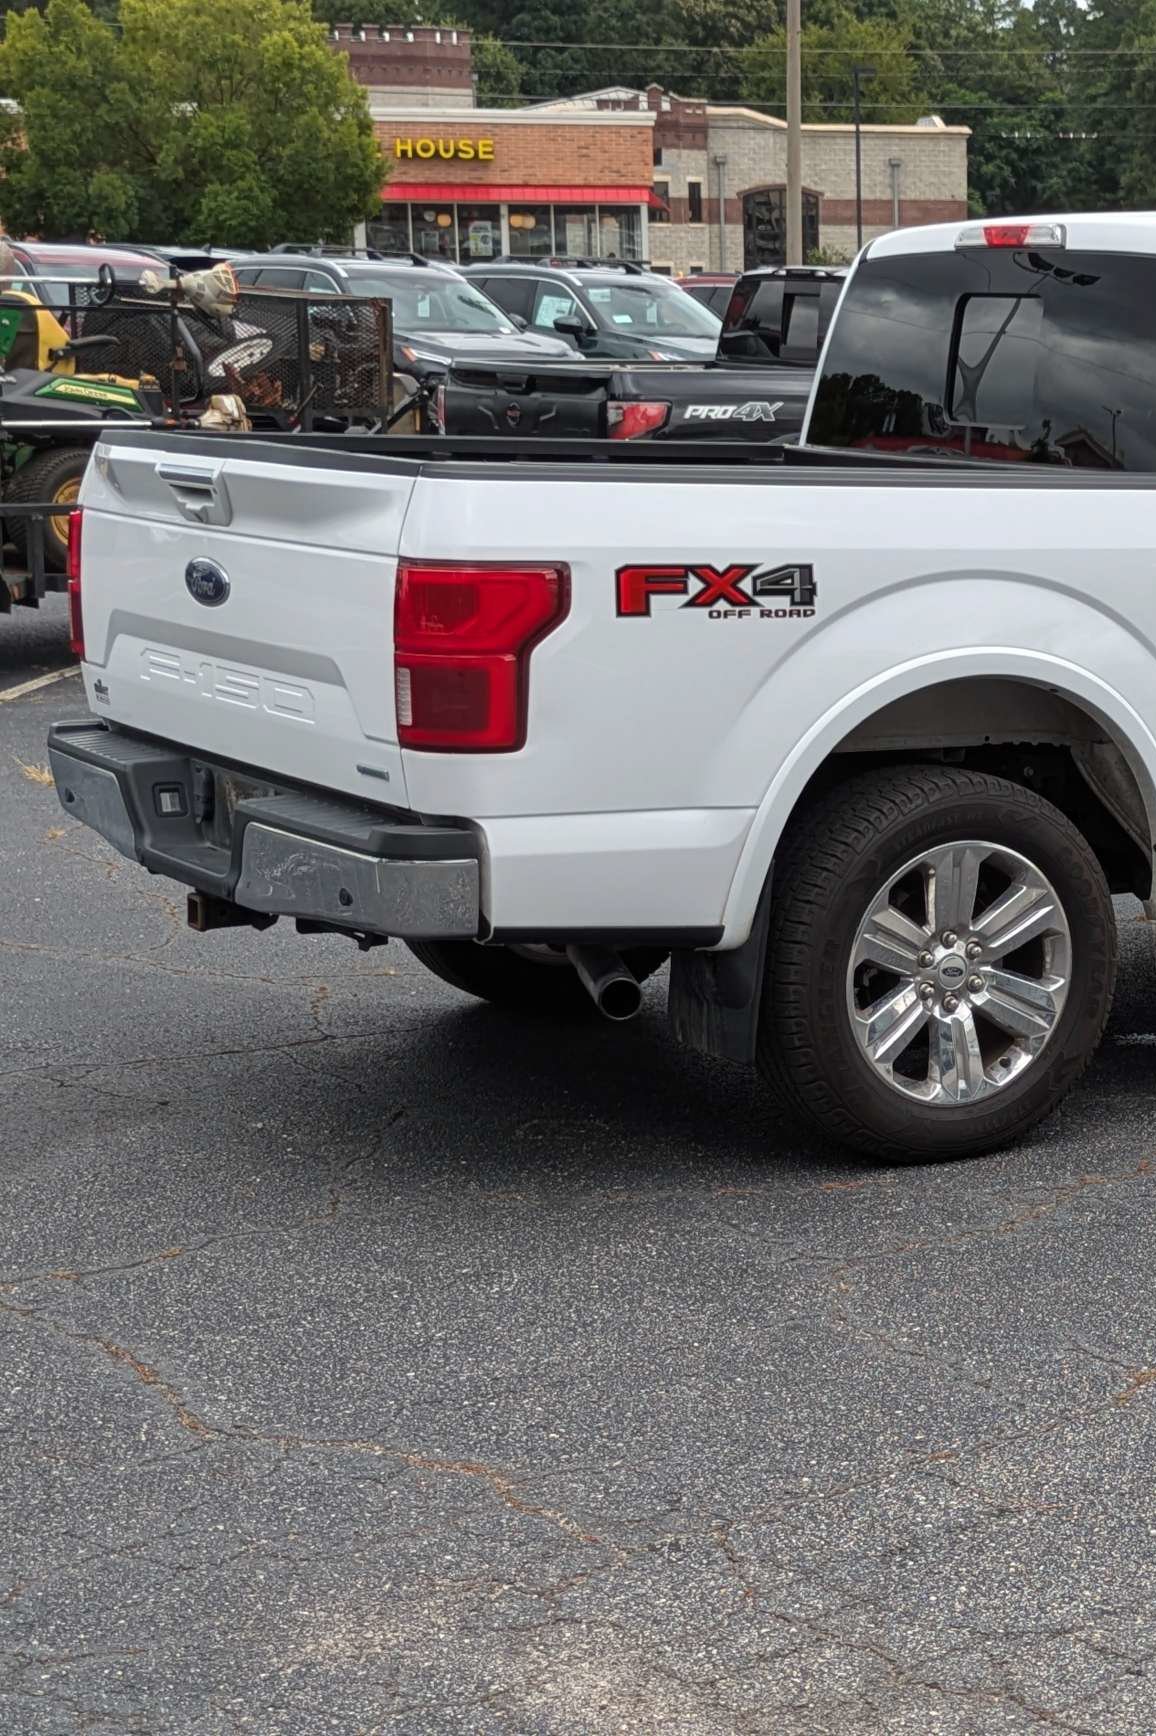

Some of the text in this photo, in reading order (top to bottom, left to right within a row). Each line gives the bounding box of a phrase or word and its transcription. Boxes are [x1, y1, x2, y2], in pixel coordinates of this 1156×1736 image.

[395, 137, 495, 160] HOUSE
[615, 563, 817, 618] FX4
[708, 608, 816, 619] OFF ROAD
[140, 647, 316, 724] F-150
